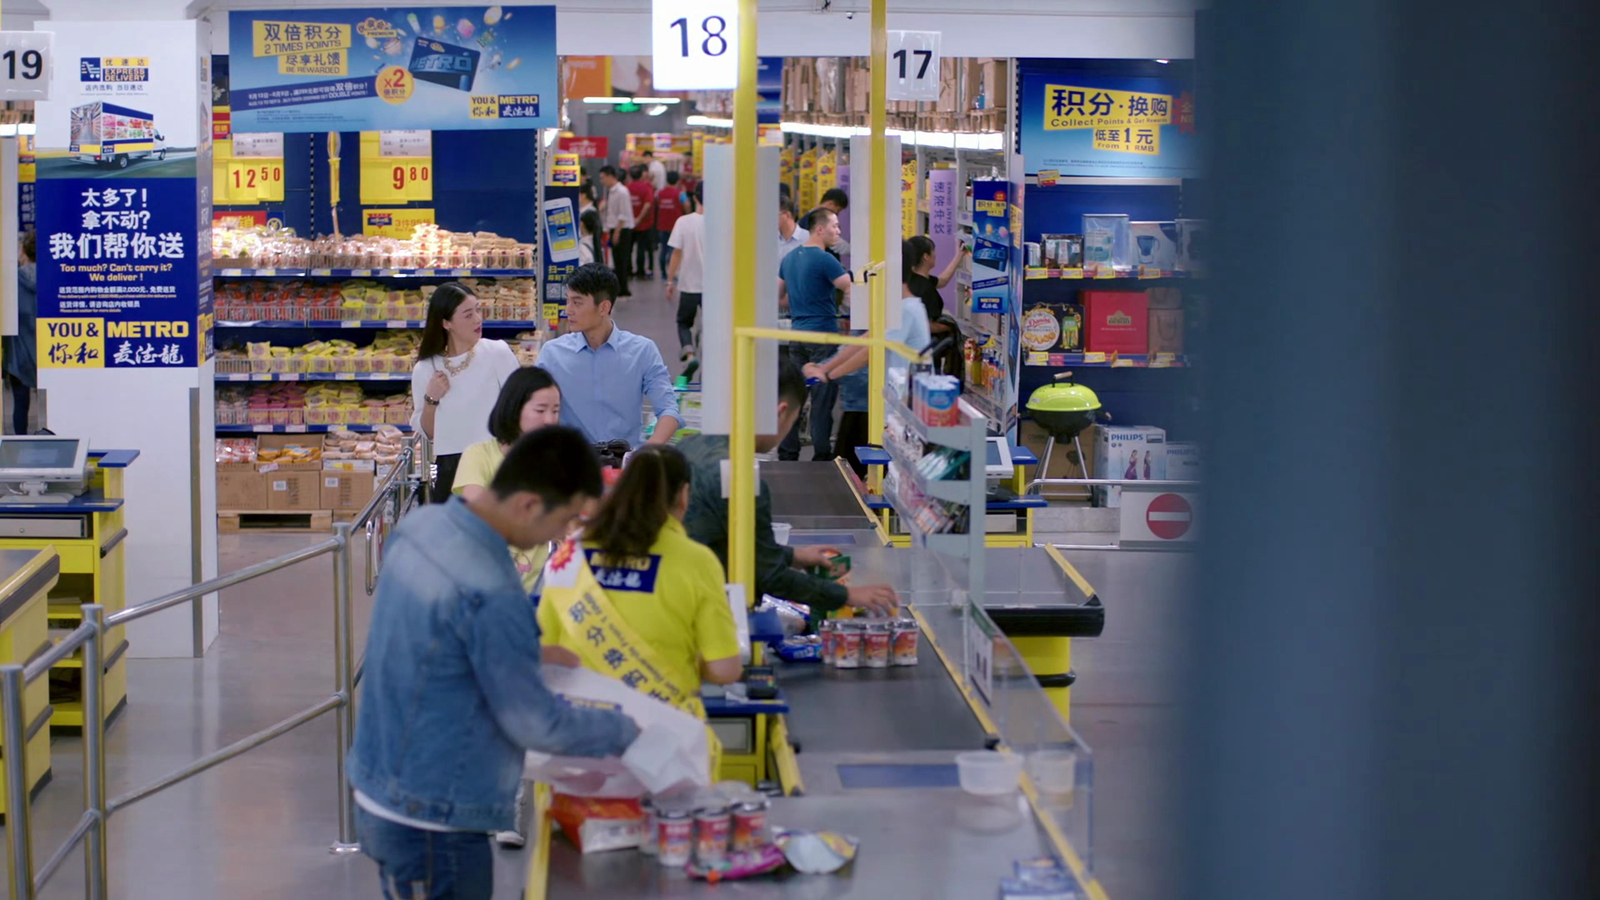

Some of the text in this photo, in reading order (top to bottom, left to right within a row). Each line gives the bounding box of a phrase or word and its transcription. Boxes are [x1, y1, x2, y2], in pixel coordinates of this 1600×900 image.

[264, 23, 342, 41] 双倍积分
[670, 16, 727, 57] 18
[264, 39, 341, 54] 2 TIMES POINTS
[2, 50, 42, 80] 19
[298, 66, 340, 74] REWARDED
[893, 50, 932, 79] 17
[472, 96, 496, 104] YOU &
[500, 95, 538, 105] METRO
[1051, 118, 1094, 127] Collect
[934, 181, 945, 235] 速溶冲饮
[50, 232, 184, 260] 我们帮你送
[60, 263, 172, 273] Too much? Can't carry it?
[89, 273, 105, 281] We
[107, 273, 137, 281] deliver
[48, 322, 99, 338] YOU &
[107, 321, 189, 338] METRO
